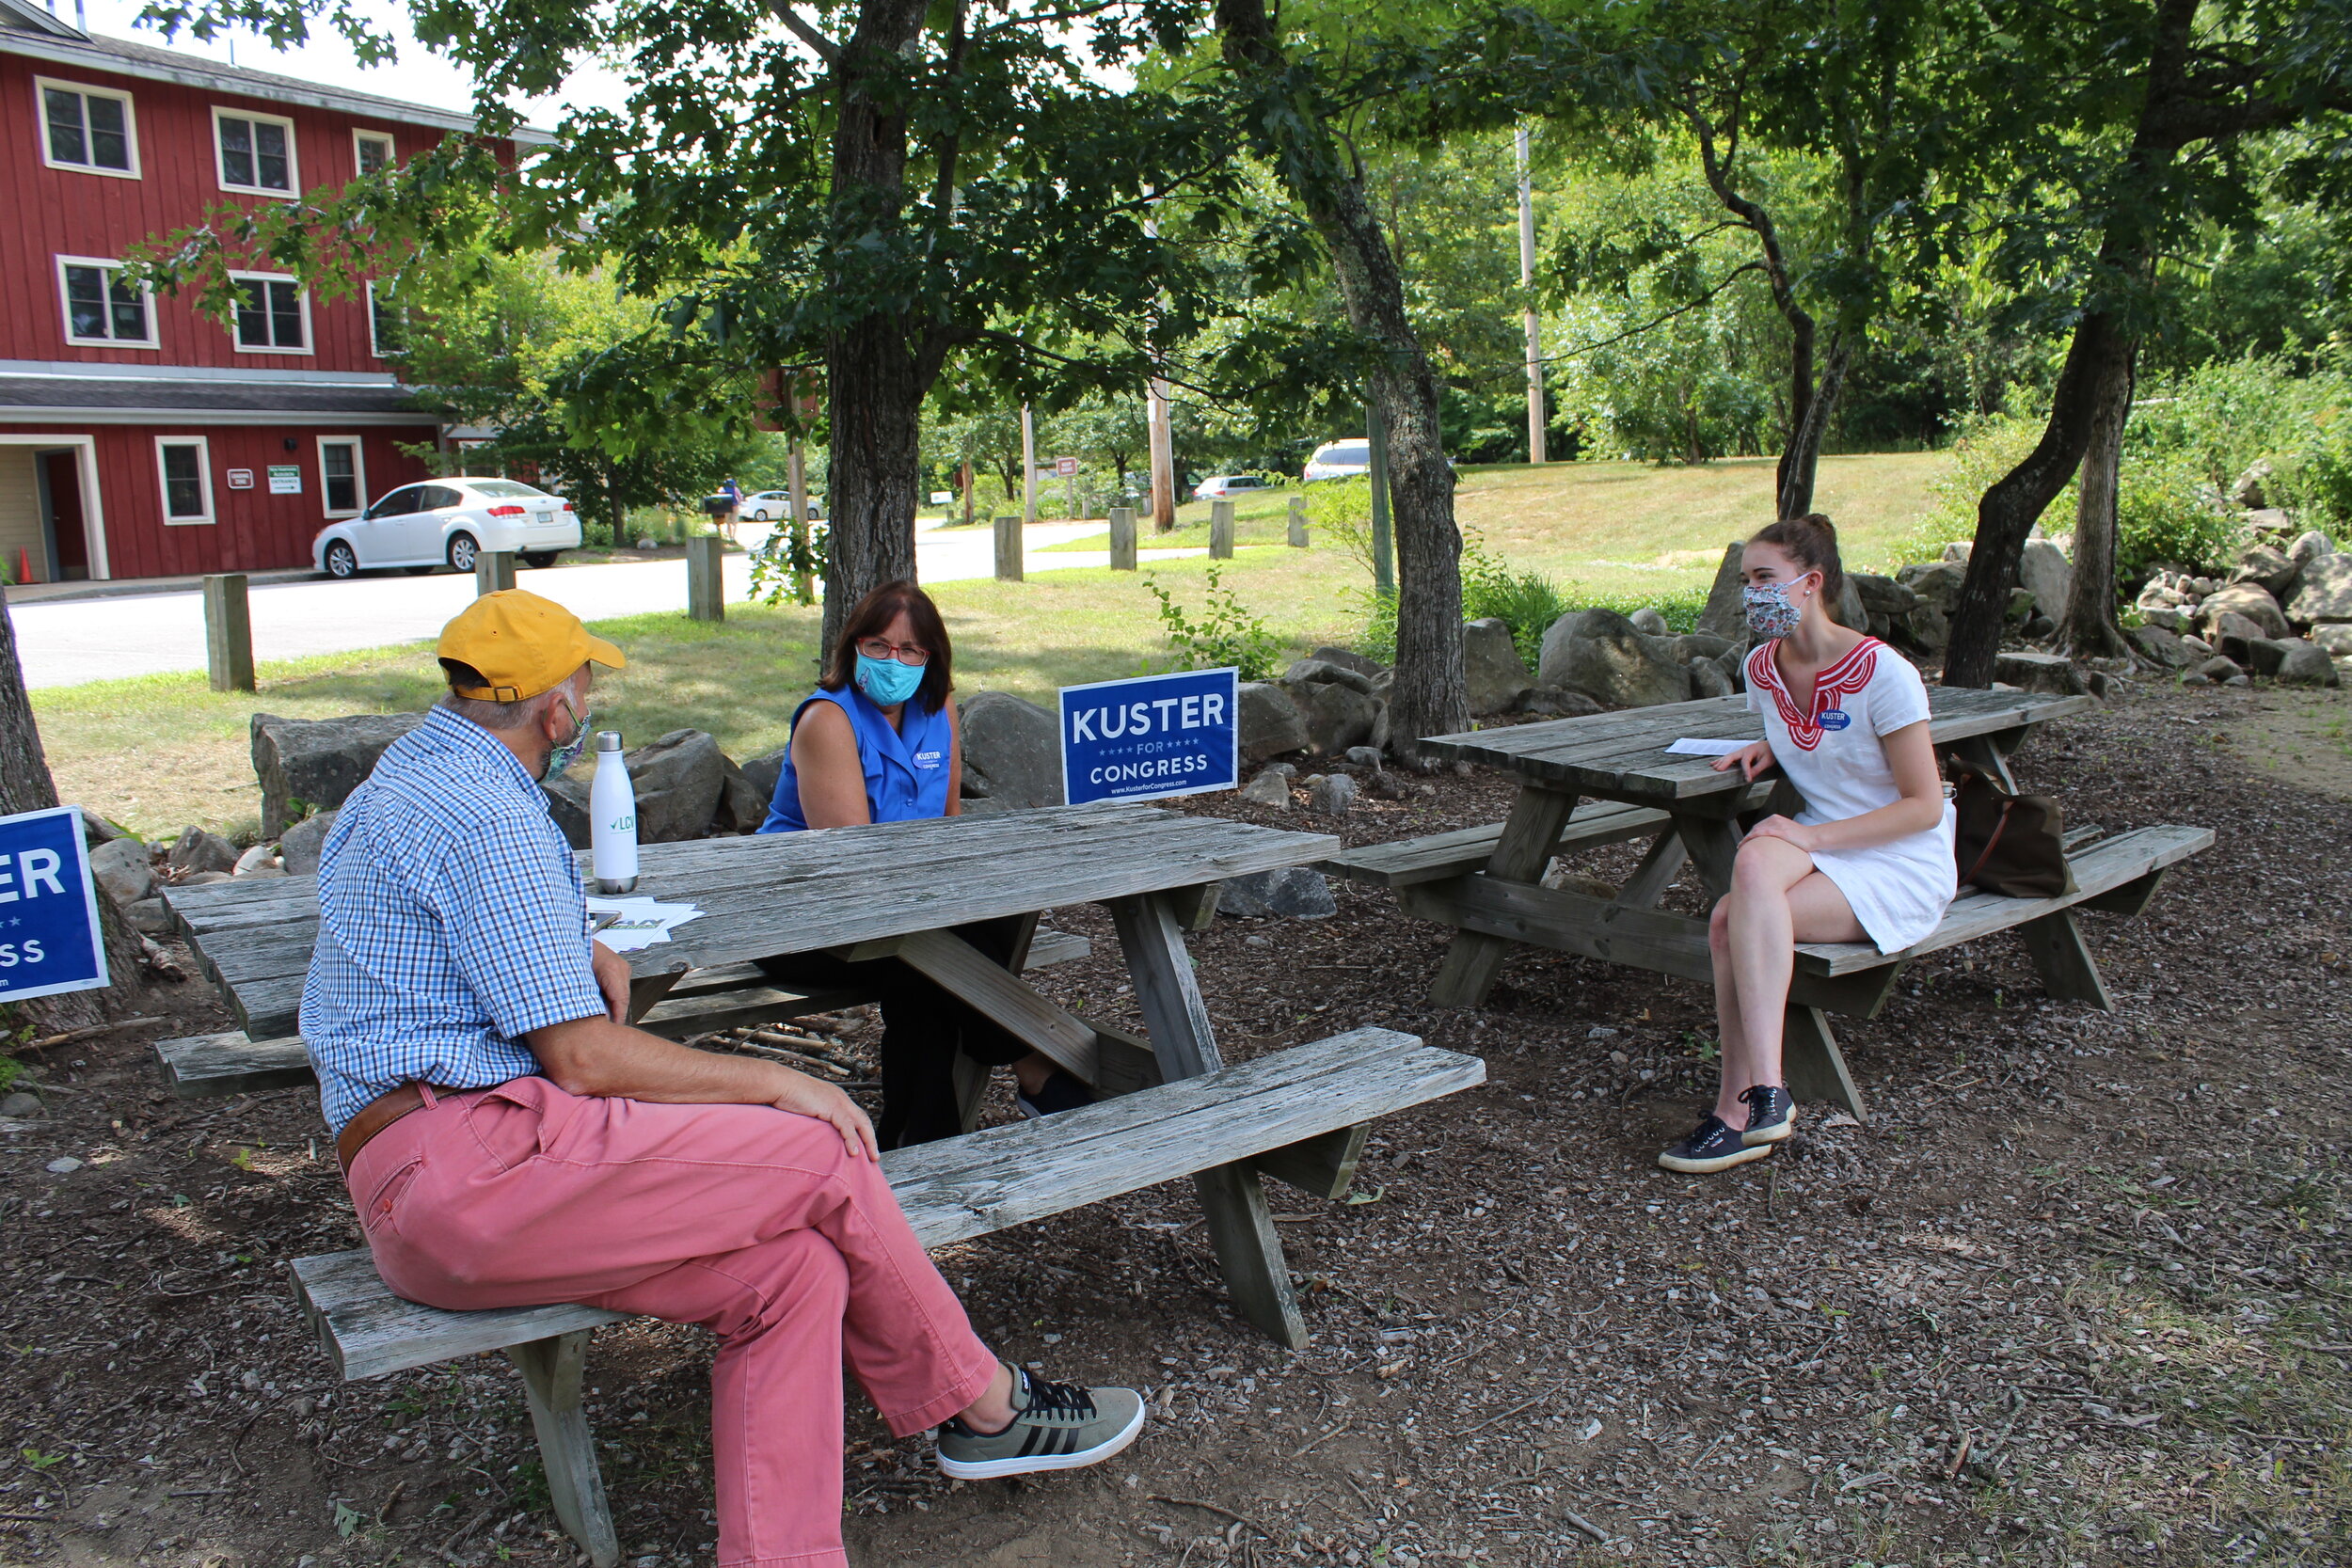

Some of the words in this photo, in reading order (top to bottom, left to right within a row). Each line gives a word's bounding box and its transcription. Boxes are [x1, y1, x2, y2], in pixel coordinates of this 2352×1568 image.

[1073, 693, 1225, 744] KUSTER
[1821, 712, 1845, 721] KUSTER
[916, 751, 942, 760] KUSTER
[1136, 741, 1164, 755] FOR
[1090, 754, 1208, 784] CONGRESS
[1111, 779, 1187, 795] www.KusterforCongress.com
